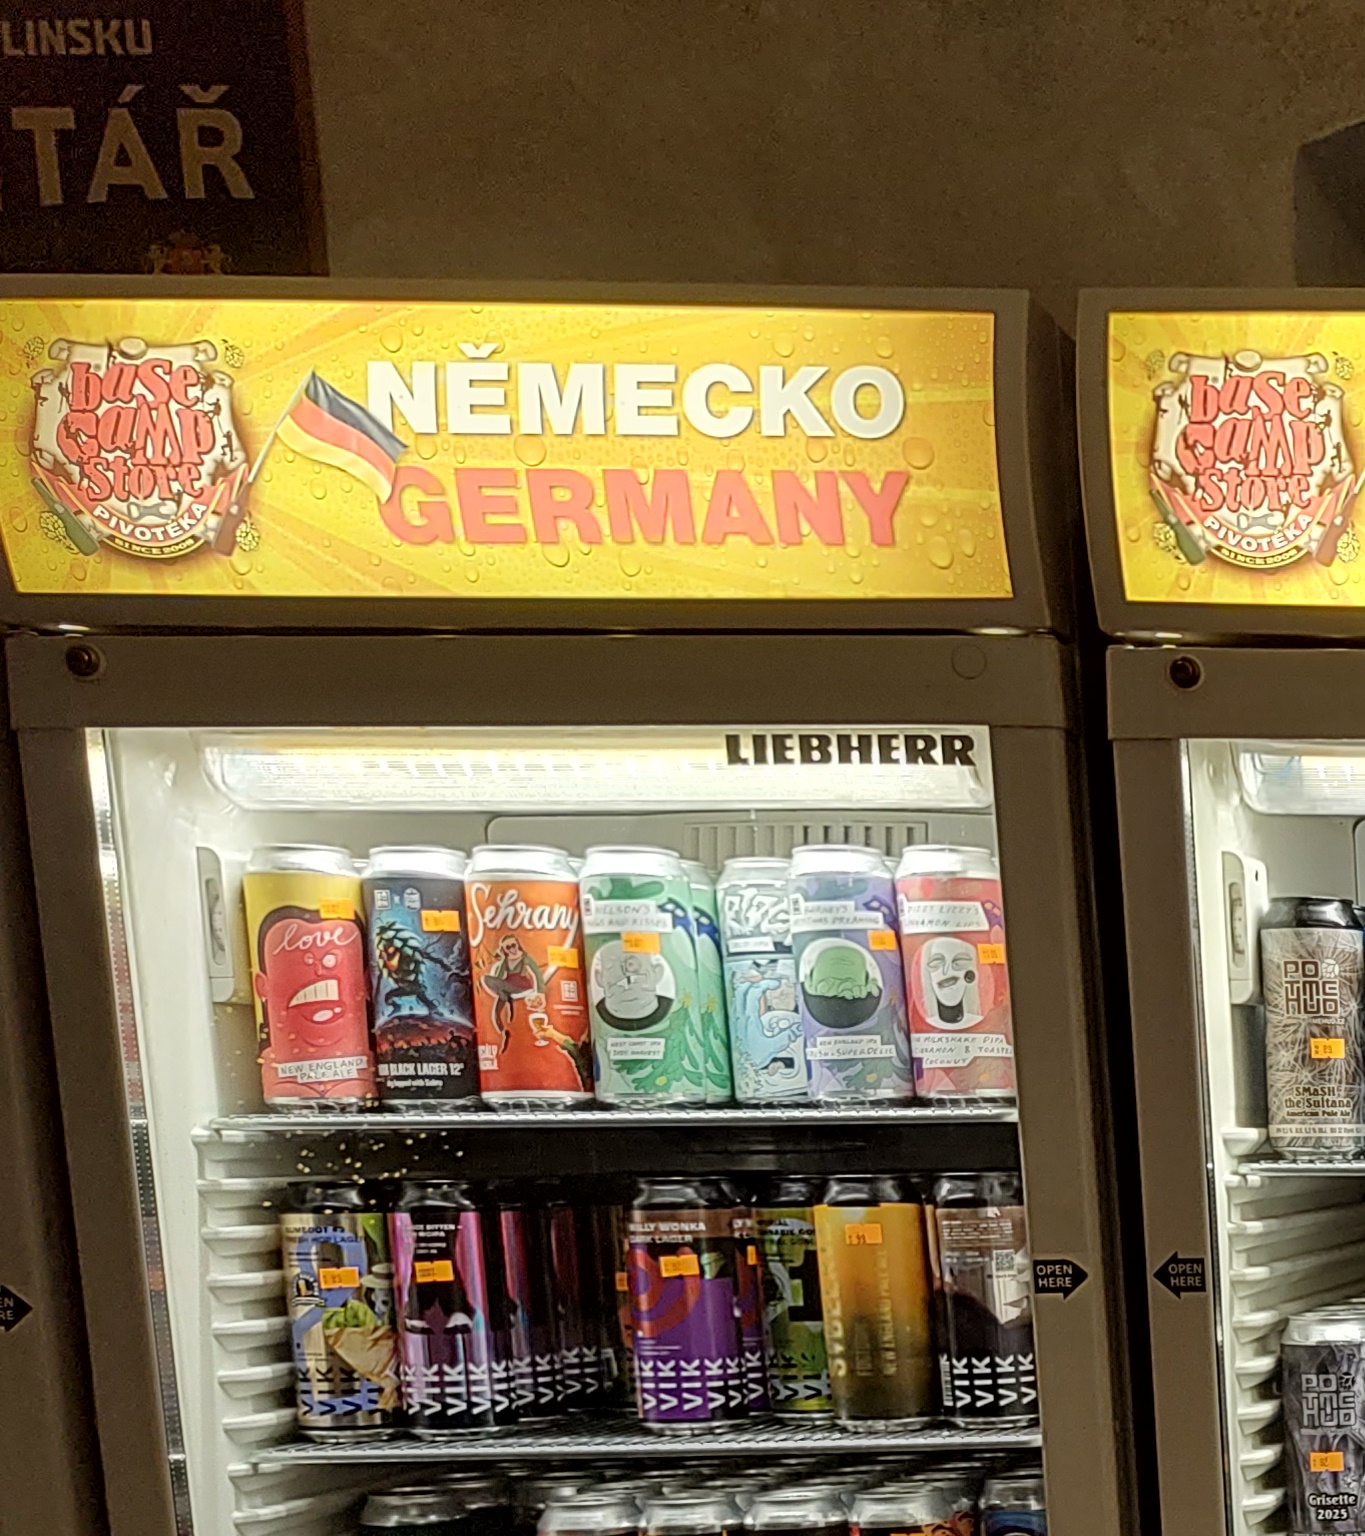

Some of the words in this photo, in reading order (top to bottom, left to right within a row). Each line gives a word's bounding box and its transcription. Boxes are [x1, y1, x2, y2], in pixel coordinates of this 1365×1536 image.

[367, 343, 906, 439] NĚMECKO
[380, 468, 909, 546] GERMANY
[93, 504, 207, 542] PIVOTÉKA
[1204, 514, 1312, 552] PIVOTÉKA
[724, 733, 978, 767] LIEBHERR
[273, 924, 359, 954] love
[1036, 1264, 1073, 1276] OPEN
[1168, 1263, 1202, 1274] OPEN
[1038, 1277, 1073, 1289] HERE
[1170, 1276, 1202, 1287] HERE
[1309, 1492, 1356, 1507] Grisette
[1317, 1508, 1348, 1521] 2025
